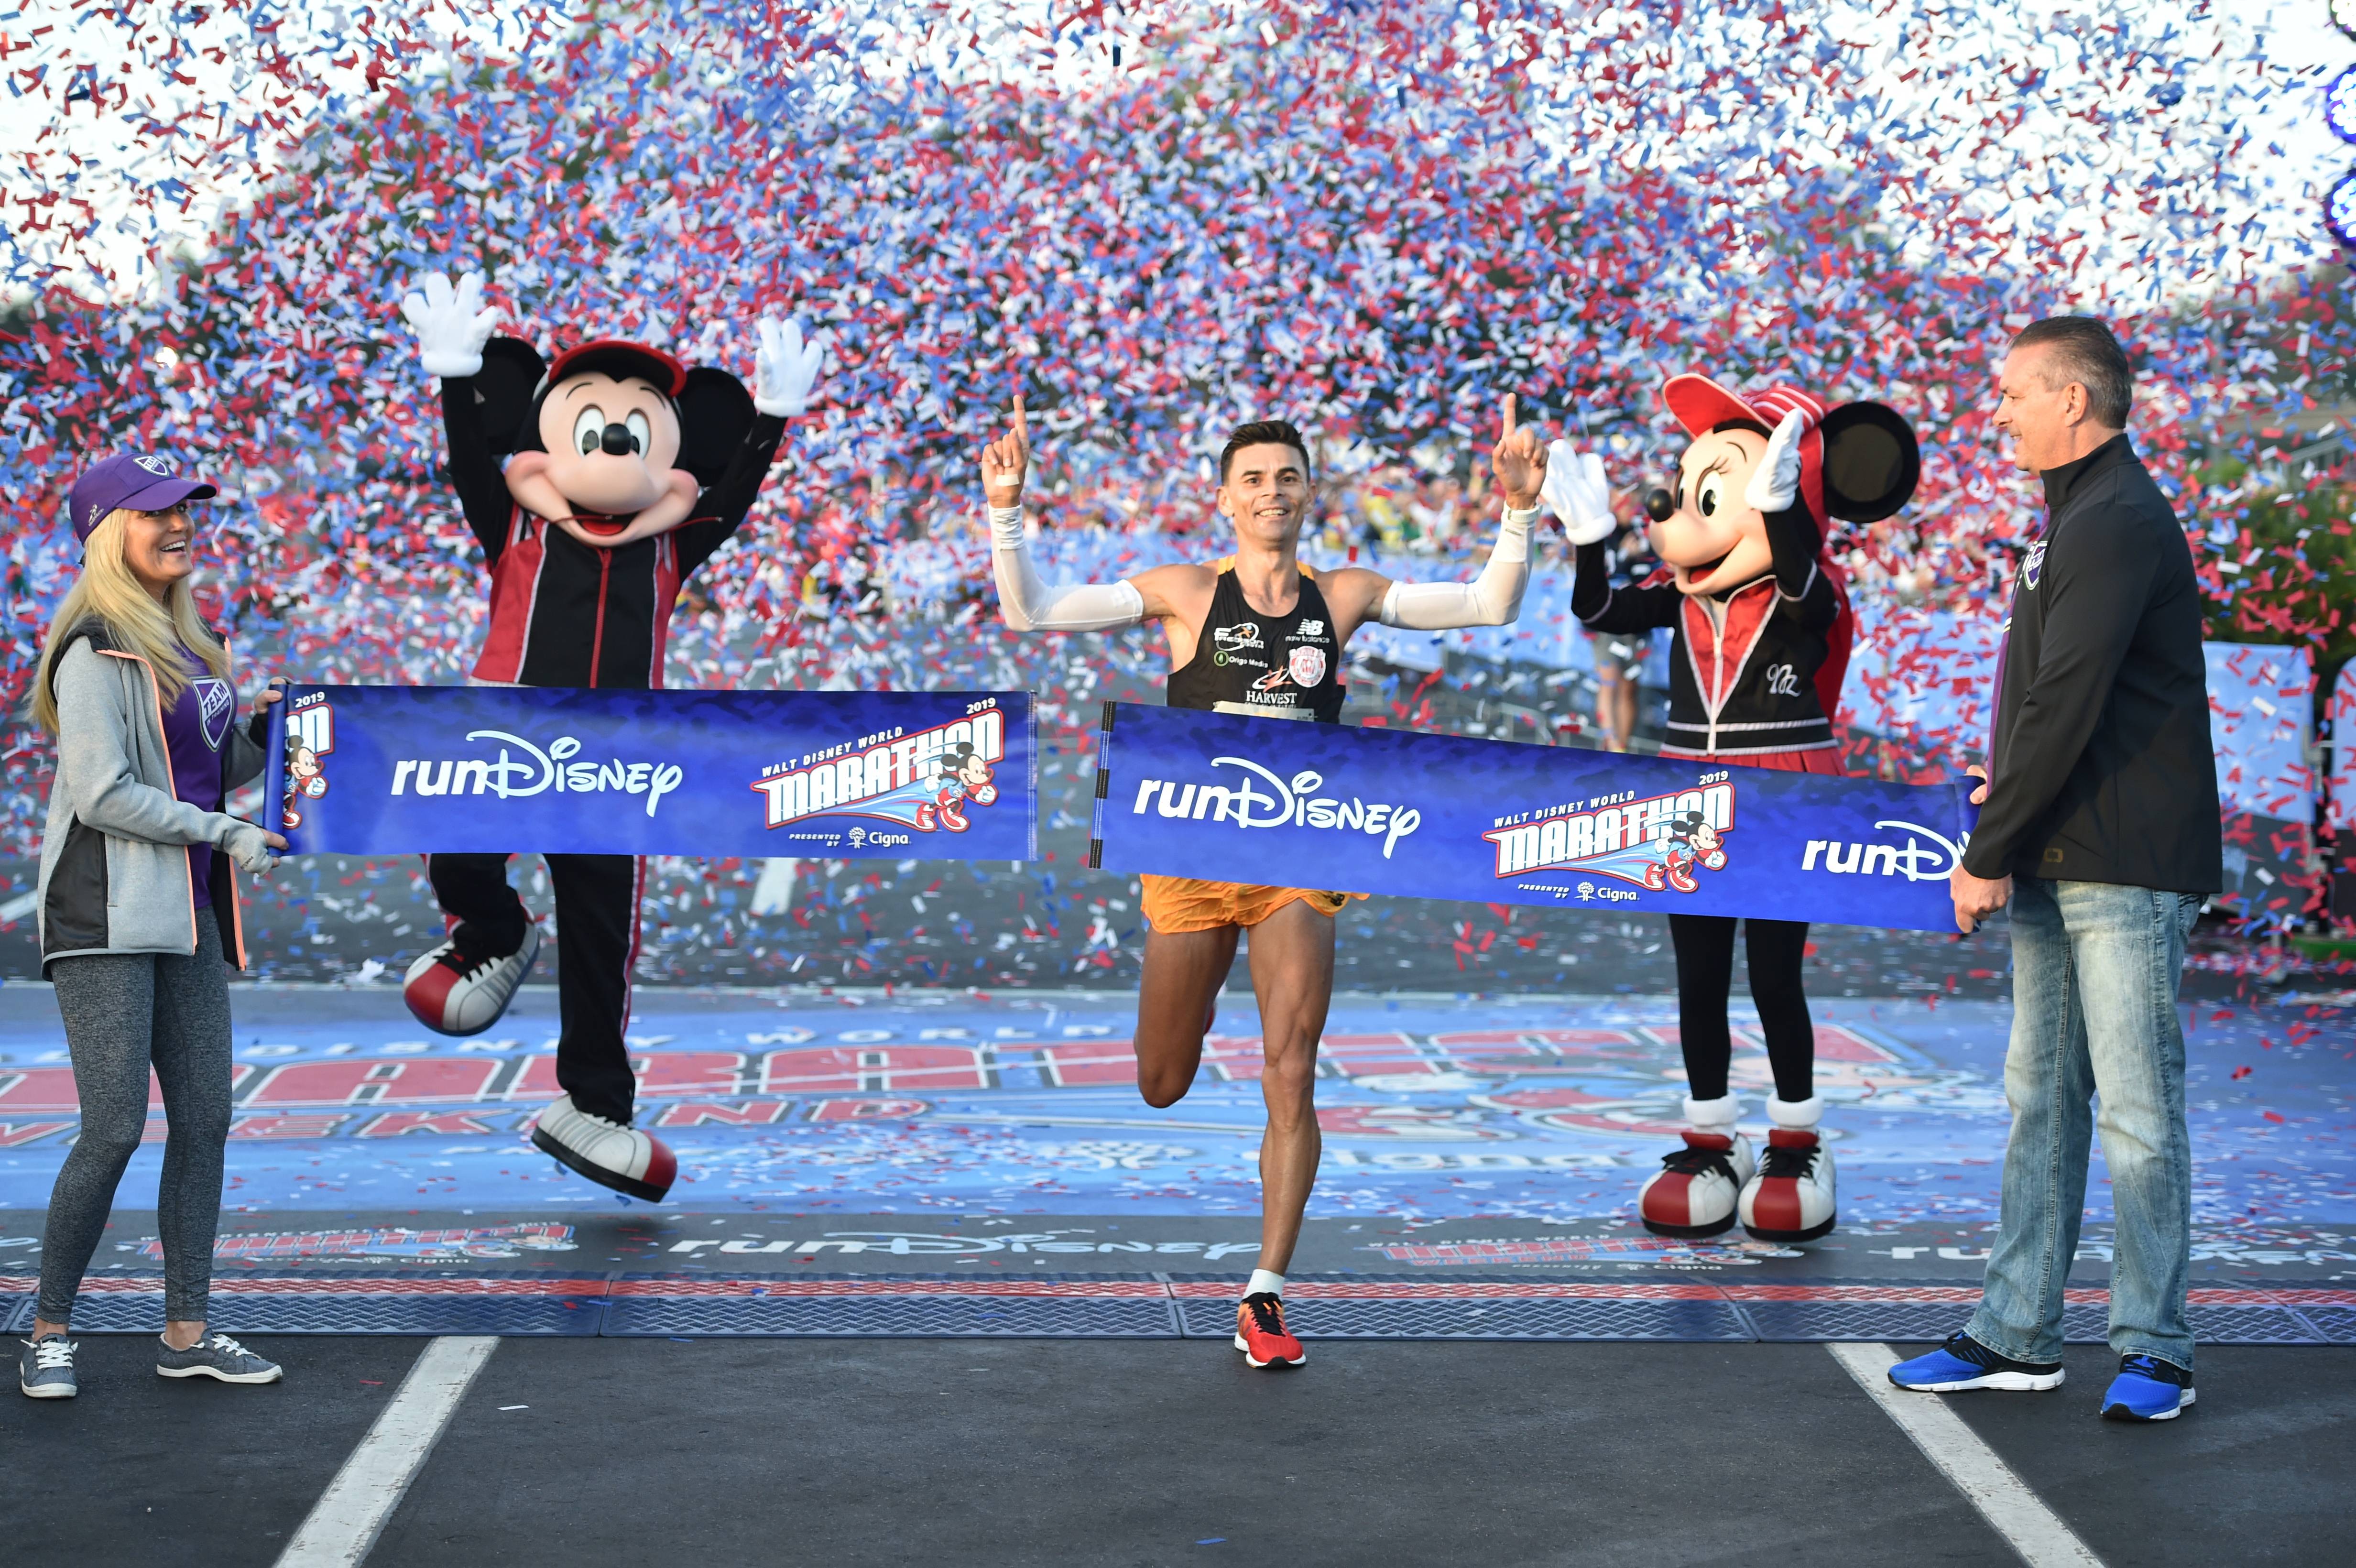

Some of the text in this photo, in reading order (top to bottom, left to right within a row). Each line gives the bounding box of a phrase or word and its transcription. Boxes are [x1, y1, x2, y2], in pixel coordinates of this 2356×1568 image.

[1302, 635, 1330, 643] balance
[204, 682, 228, 716] TEAM
[294, 691, 325, 708] 2019
[966, 697, 997, 715] 2019
[1245, 690, 1298, 704] HARVEST
[206, 698, 229, 726] IN TRAINING
[762, 726, 903, 777] WALT DISNEY WORLD
[753, 711, 1001, 826] MARATHON
[1698, 770, 1729, 786] 2019
[1494, 790, 1636, 828] WALT DISNEY WORLD
[1485, 784, 1730, 875] MARATHON
[869, 831, 909, 848] Cigna
[1517, 883, 1570, 893] PRESENTED
[1597, 887, 1636, 902] Cigna
[747, 1024, 1112, 1045] WORLD
[1242, 1150, 1621, 1169] igna
